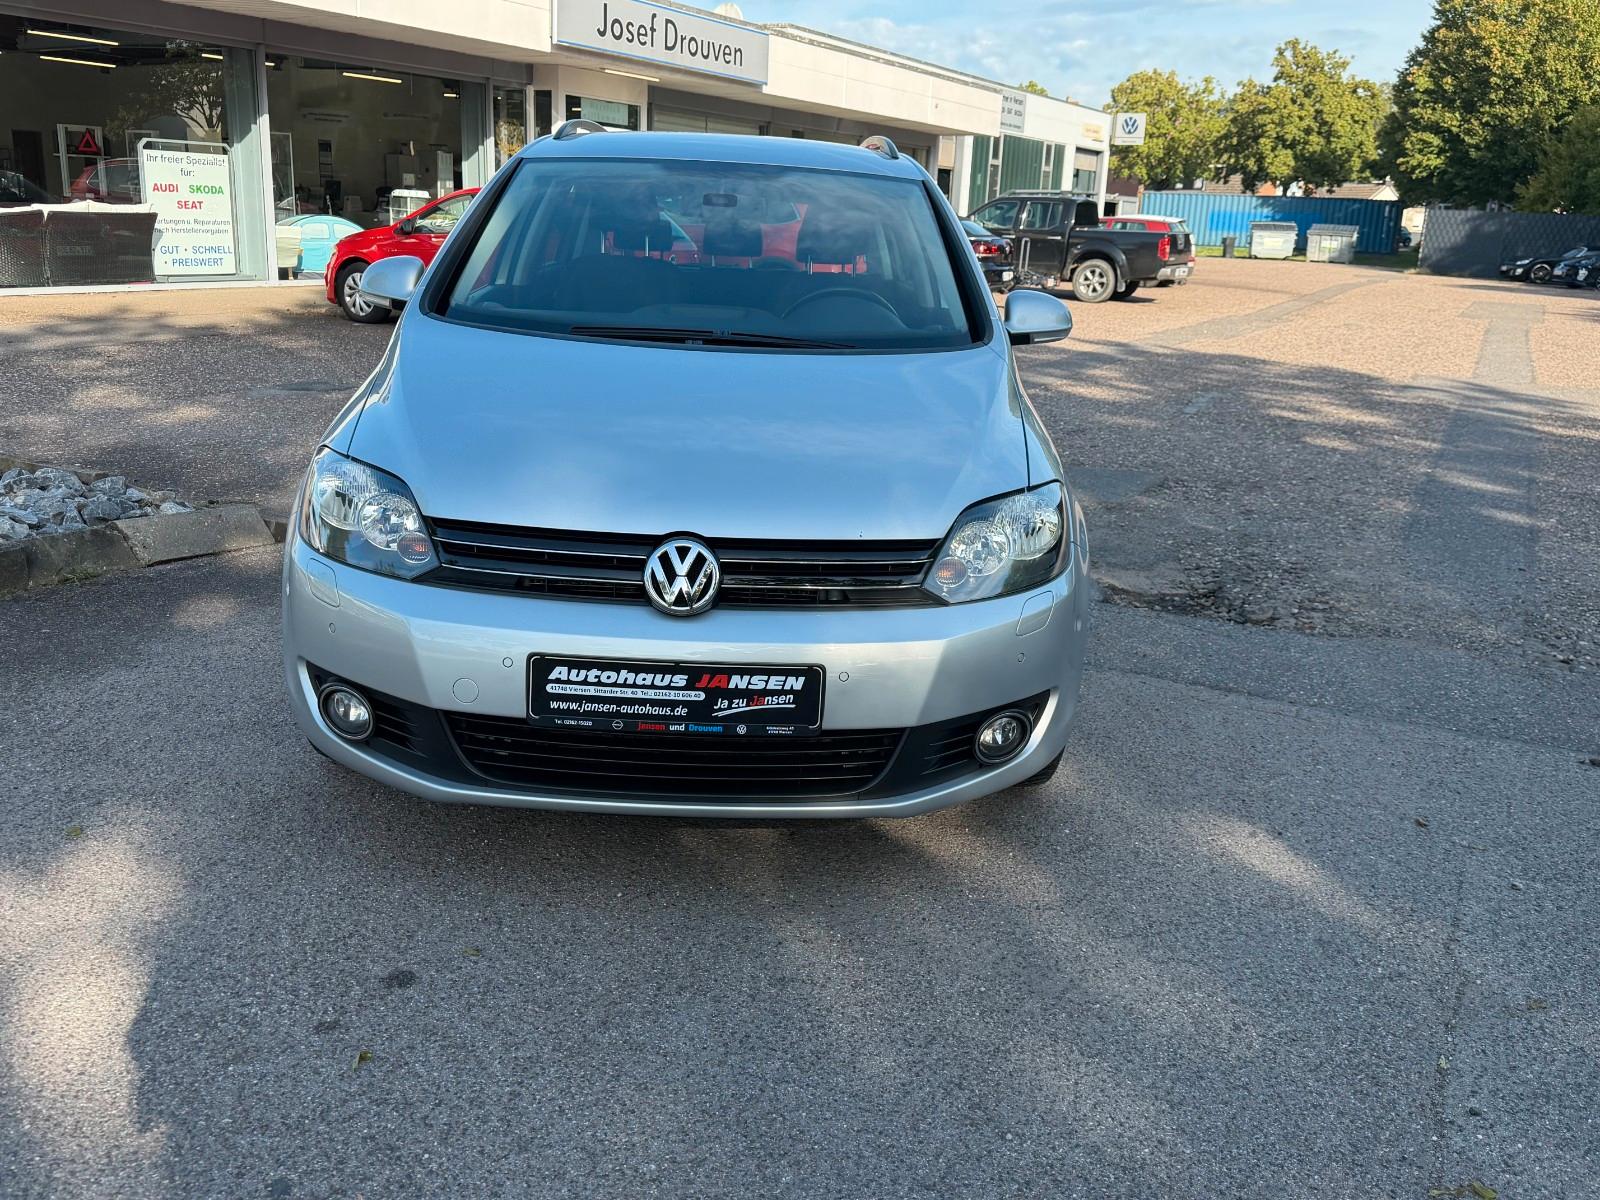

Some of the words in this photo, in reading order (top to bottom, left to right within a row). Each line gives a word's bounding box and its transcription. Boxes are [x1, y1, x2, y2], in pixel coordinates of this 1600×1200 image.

[597, 3, 657, 47] Josef
[664, 18, 743, 67] Drouven
[146, 153, 159, 162] Ihr
[160, 154, 184, 164] freier
[186, 156, 225, 167] Spezialist
[180, 168, 195, 177] für:
[152, 183, 179, 193] AUDI
[188, 185, 225, 195] SKODA
[176, 200, 204, 210] SEAT
[160, 245, 180, 255] GUT
[191, 246, 233, 255] SCHNELL
[172, 258, 224, 267] PREISWERT
[644, 539, 720, 616] VW
[547, 666, 688, 686] Autohaus
[695, 673, 806, 691] JANSEN
[549, 684, 568, 692] 41748
[550, 700, 688, 716] www.jansen-autohaus.de
[714, 698, 728, 709] Ja
[732, 698, 747, 707] zu
[750, 695, 794, 706] Jansen
[669, 722, 685, 731] und
[688, 723, 723, 733] Drouven
